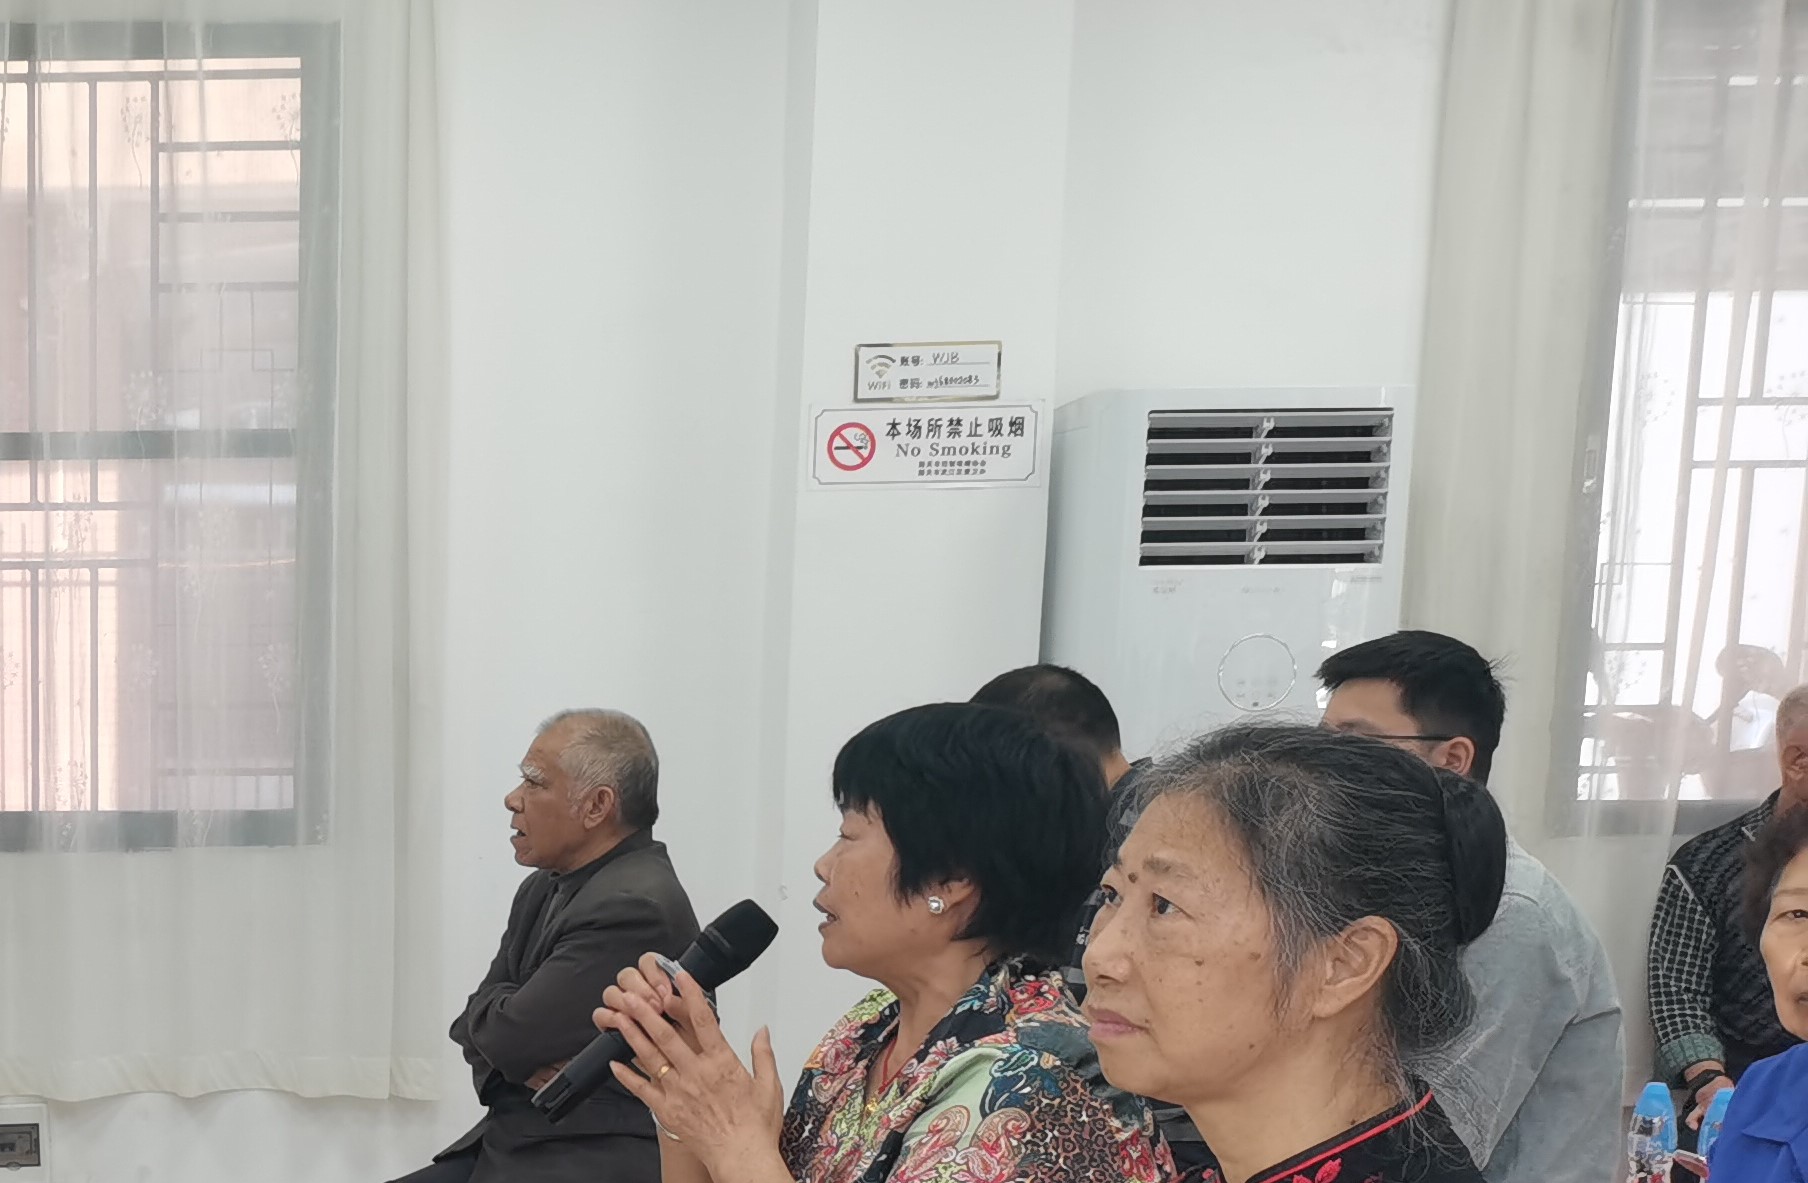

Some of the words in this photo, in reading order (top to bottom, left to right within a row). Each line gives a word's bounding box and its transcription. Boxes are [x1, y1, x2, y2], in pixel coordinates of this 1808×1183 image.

[885, 415, 1026, 441] 本场所禁止吸烟
[895, 443, 921, 458] No
[929, 441, 1012, 459] Smoking
